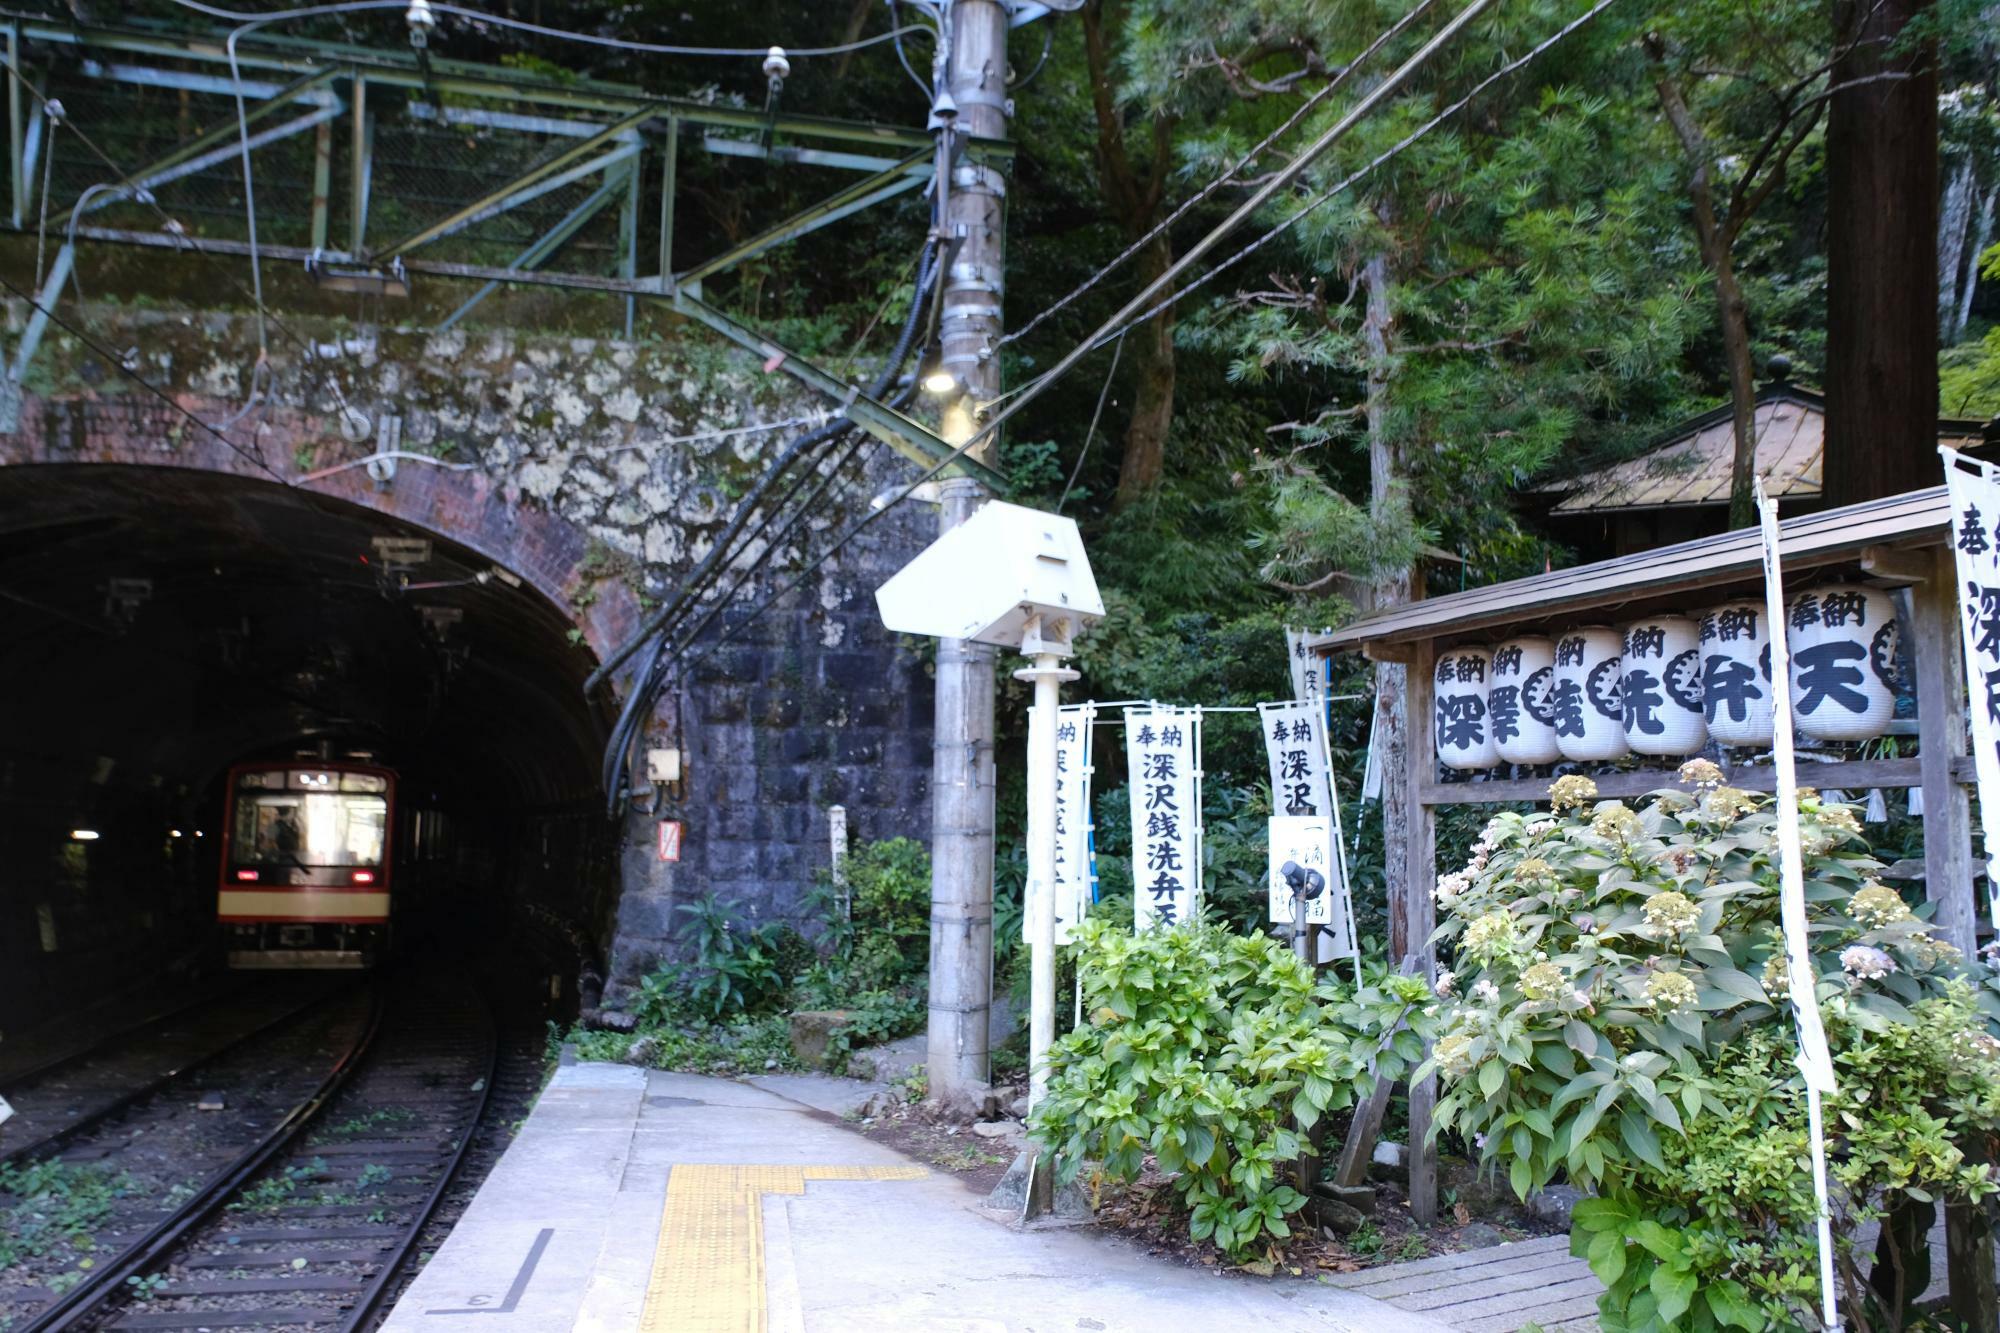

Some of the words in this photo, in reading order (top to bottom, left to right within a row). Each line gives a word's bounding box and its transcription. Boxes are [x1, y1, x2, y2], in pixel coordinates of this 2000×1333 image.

[1790, 591, 1867, 632] 奉納
[1436, 655, 1486, 685] 奉納
[1492, 645, 1523, 676] 納
[1555, 636, 1586, 667] 納
[1702, 654, 1763, 725] 弁
[1793, 640, 1869, 716] 天
[1437, 694, 1486, 750] 深
[1622, 669, 1665, 735] 洗
[1135, 724, 1182, 748] 奉納
[1272, 718, 1312, 745] 奉納
[1143, 753, 1185, 927] 深沢銭洗弁天
